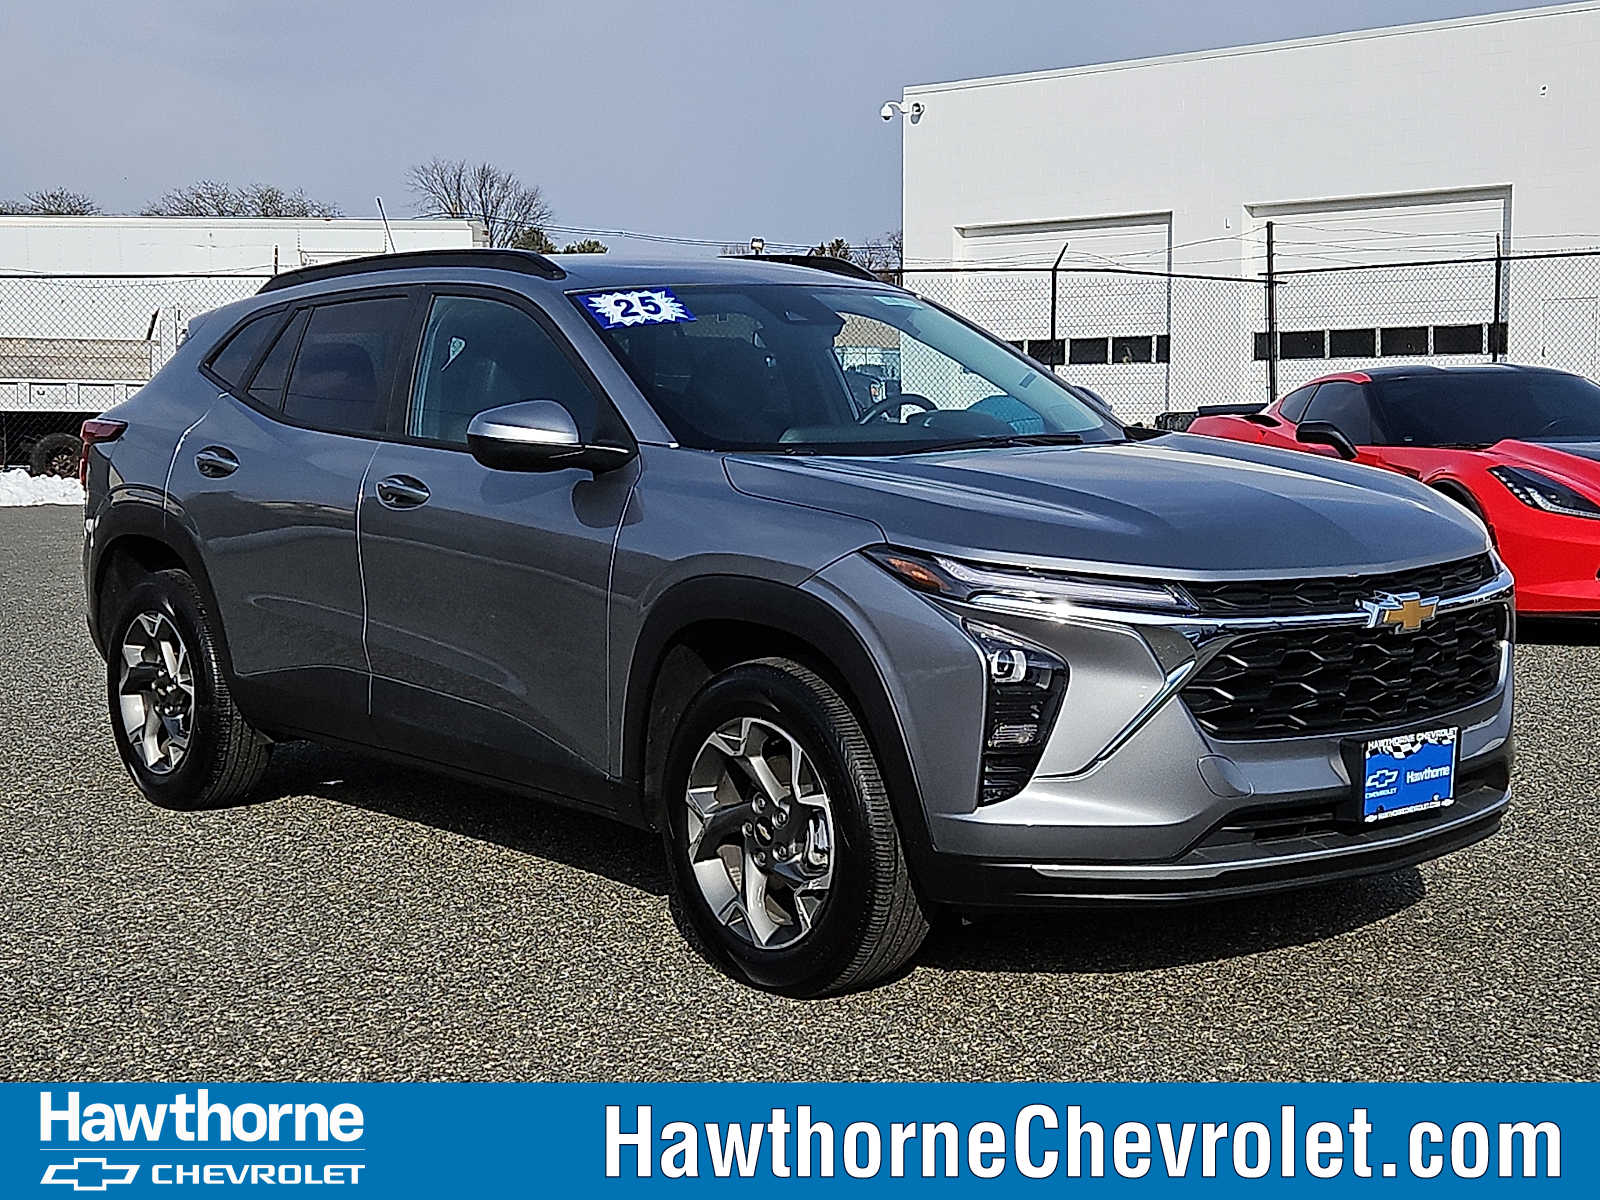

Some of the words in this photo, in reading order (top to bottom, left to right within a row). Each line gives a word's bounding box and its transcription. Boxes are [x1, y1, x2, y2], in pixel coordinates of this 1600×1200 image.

[613, 295, 661, 317] 25
[1368, 733, 1416, 750] HAWTHORNE
[1416, 727, 1456, 741] CHEVROLET
[1406, 766, 1451, 783] Hawthorne
